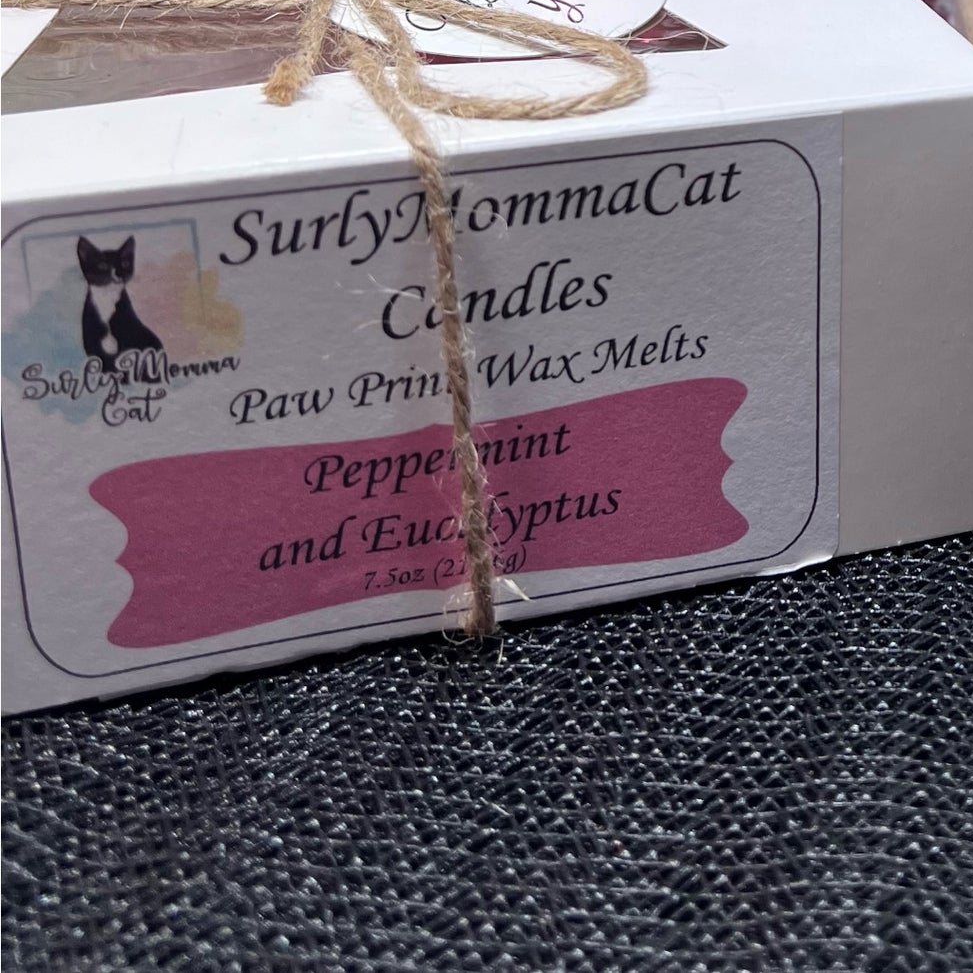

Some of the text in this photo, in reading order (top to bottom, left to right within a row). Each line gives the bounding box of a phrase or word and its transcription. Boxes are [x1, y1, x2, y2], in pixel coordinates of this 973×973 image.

[101, 387, 167, 427] Cat
[229, 324, 710, 425] Paw Prin Wax Melts
[258, 487, 623, 572] and Euclyptus
[364, 543, 528, 591] 7.5oz (216g)
